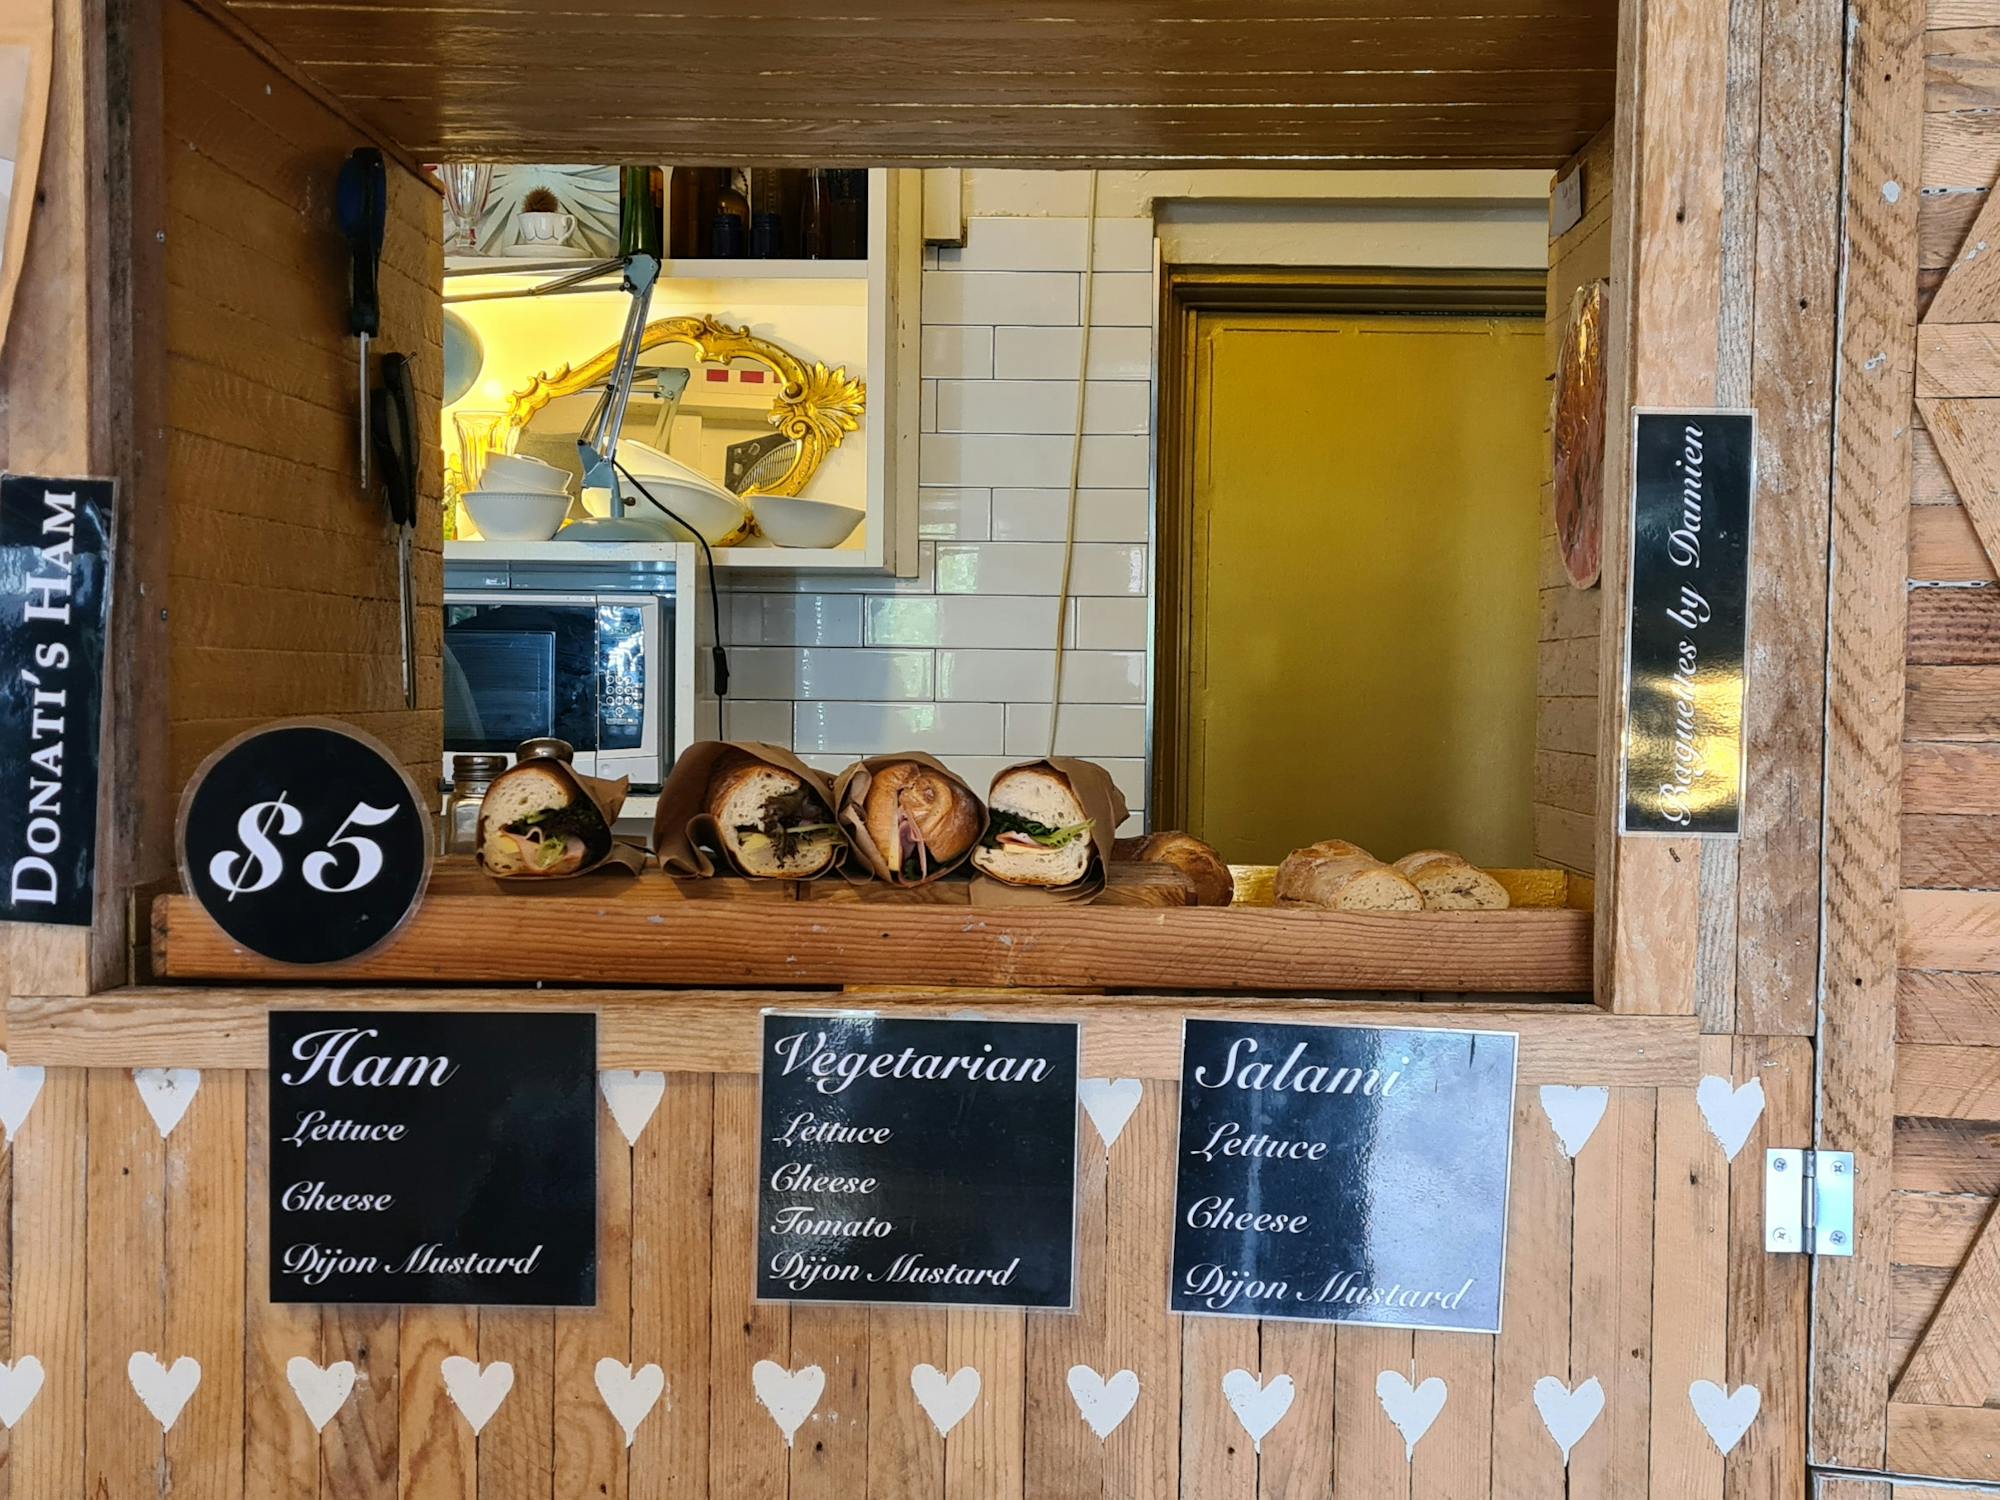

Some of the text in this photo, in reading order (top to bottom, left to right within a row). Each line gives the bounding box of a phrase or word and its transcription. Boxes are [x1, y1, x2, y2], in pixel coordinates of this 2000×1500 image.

[1657, 420, 1711, 827] Baguettes by Damien
[11, 490, 77, 905] DONATI'S HAM
[209, 790, 400, 901] $5
[281, 1028, 460, 1087] Ham
[774, 1032, 1055, 1095] Vegetarian
[1195, 1037, 1411, 1097] Salami
[281, 1110, 409, 1148] Lettuce
[772, 1112, 894, 1148] Lettuce
[1190, 1122, 1329, 1162] Lettuce
[281, 1181, 397, 1212] Cheese
[770, 1163, 880, 1195] Cheese
[770, 1206, 897, 1238] Tomato
[1186, 1195, 1311, 1234] Cheese
[281, 1242, 543, 1286] Dijon Mustard
[769, 1250, 1021, 1291] Dijon Mustard
[1184, 1263, 1473, 1310] Dijon Mustard
